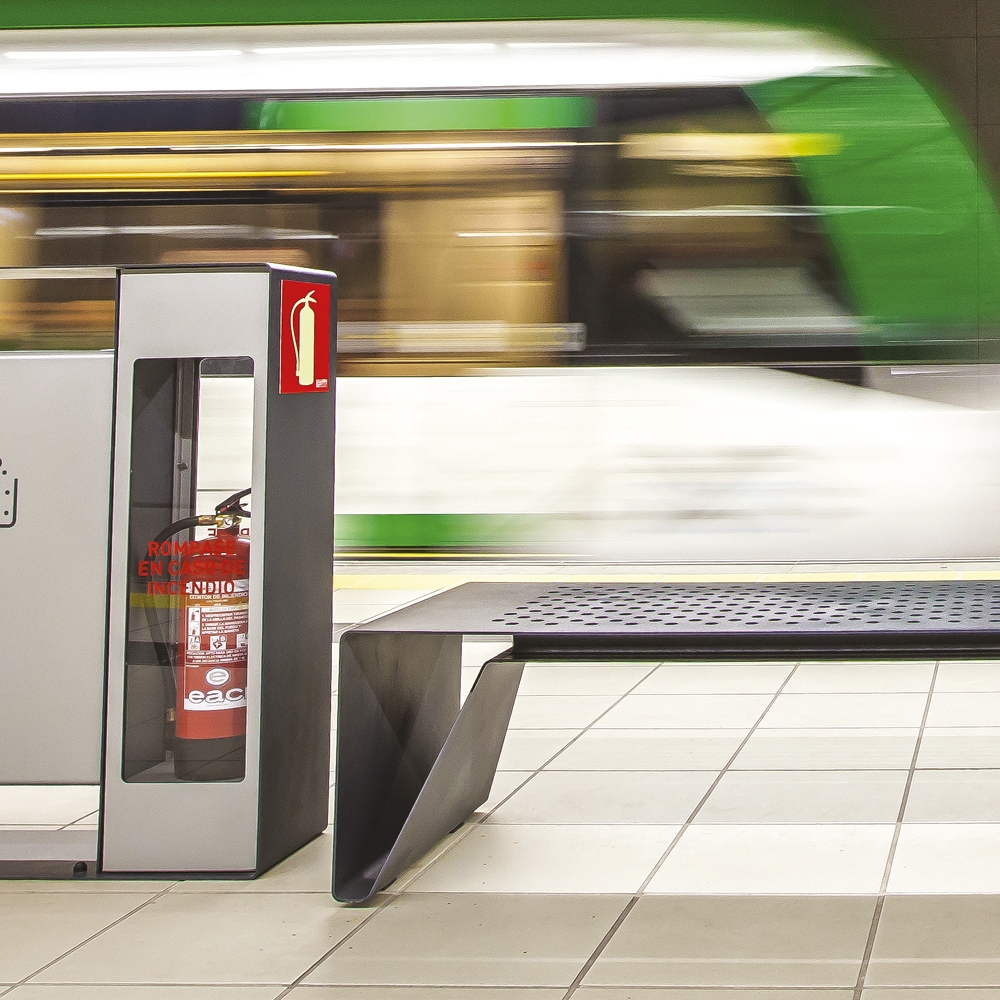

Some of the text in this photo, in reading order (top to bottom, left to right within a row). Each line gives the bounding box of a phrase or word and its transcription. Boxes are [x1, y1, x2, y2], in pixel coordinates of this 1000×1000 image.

[147, 540, 235, 557] ROMPASE
[138, 559, 245, 576] EN CASO DE
[147, 580, 235, 596] INCENDIO
